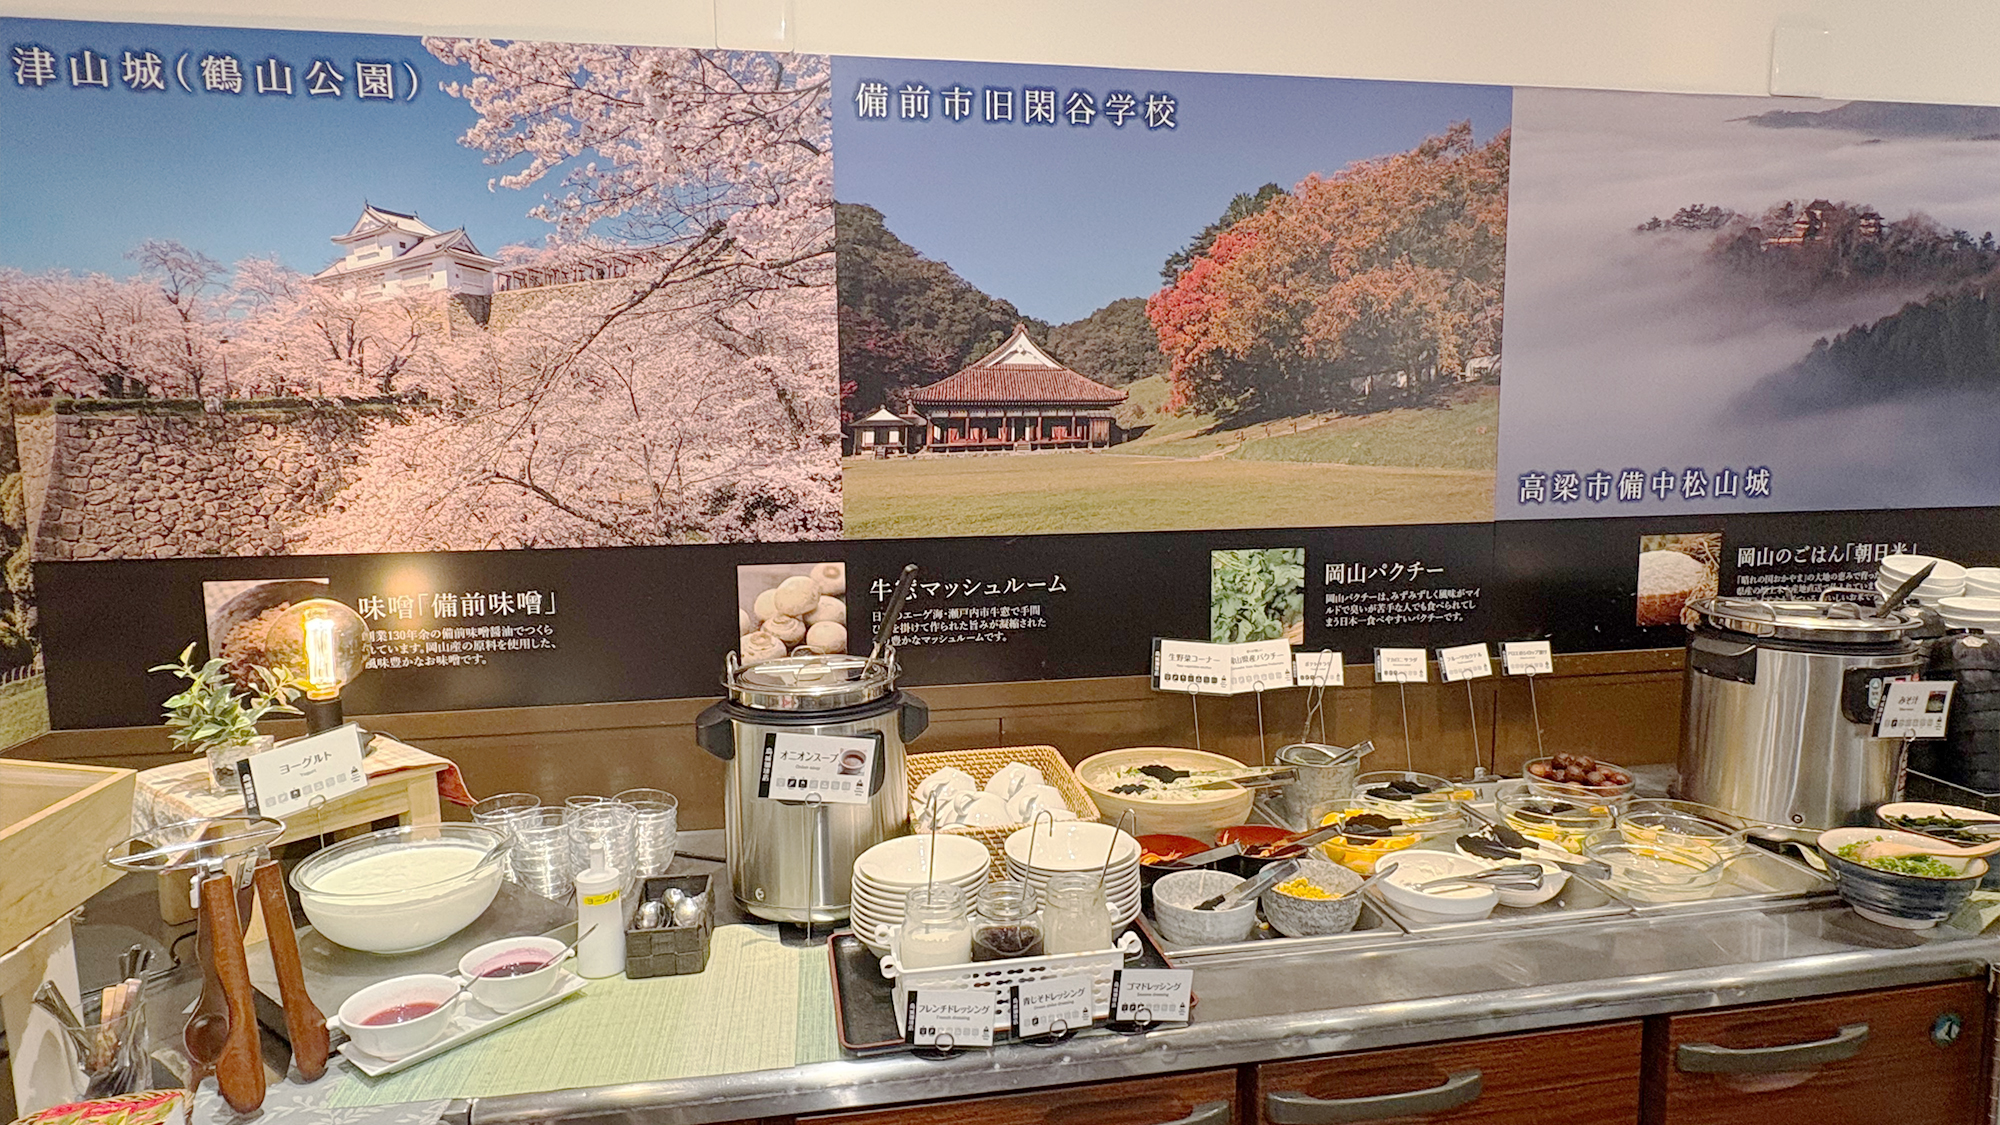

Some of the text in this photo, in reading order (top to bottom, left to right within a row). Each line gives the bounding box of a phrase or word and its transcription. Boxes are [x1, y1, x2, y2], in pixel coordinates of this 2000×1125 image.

[12, 46, 419, 101] 津山城（鶴山公園）
[855, 82, 1177, 128] 備前市旧閑谷学校
[1519, 468, 1771, 503] 高梁市備中松山城
[1325, 560, 1445, 586] 岡山パクチー
[358, 589, 557, 621] 味噌「備前味噌」
[279, 751, 332, 775] ヨーグルト
[780, 750, 840, 763] オニオンスープ
[1023, 987, 1085, 1007] 青じそドレッシング
[1127, 982, 1181, 991] ゴマドレッシング
[918, 1004, 990, 1015] フレンチドレッシング
